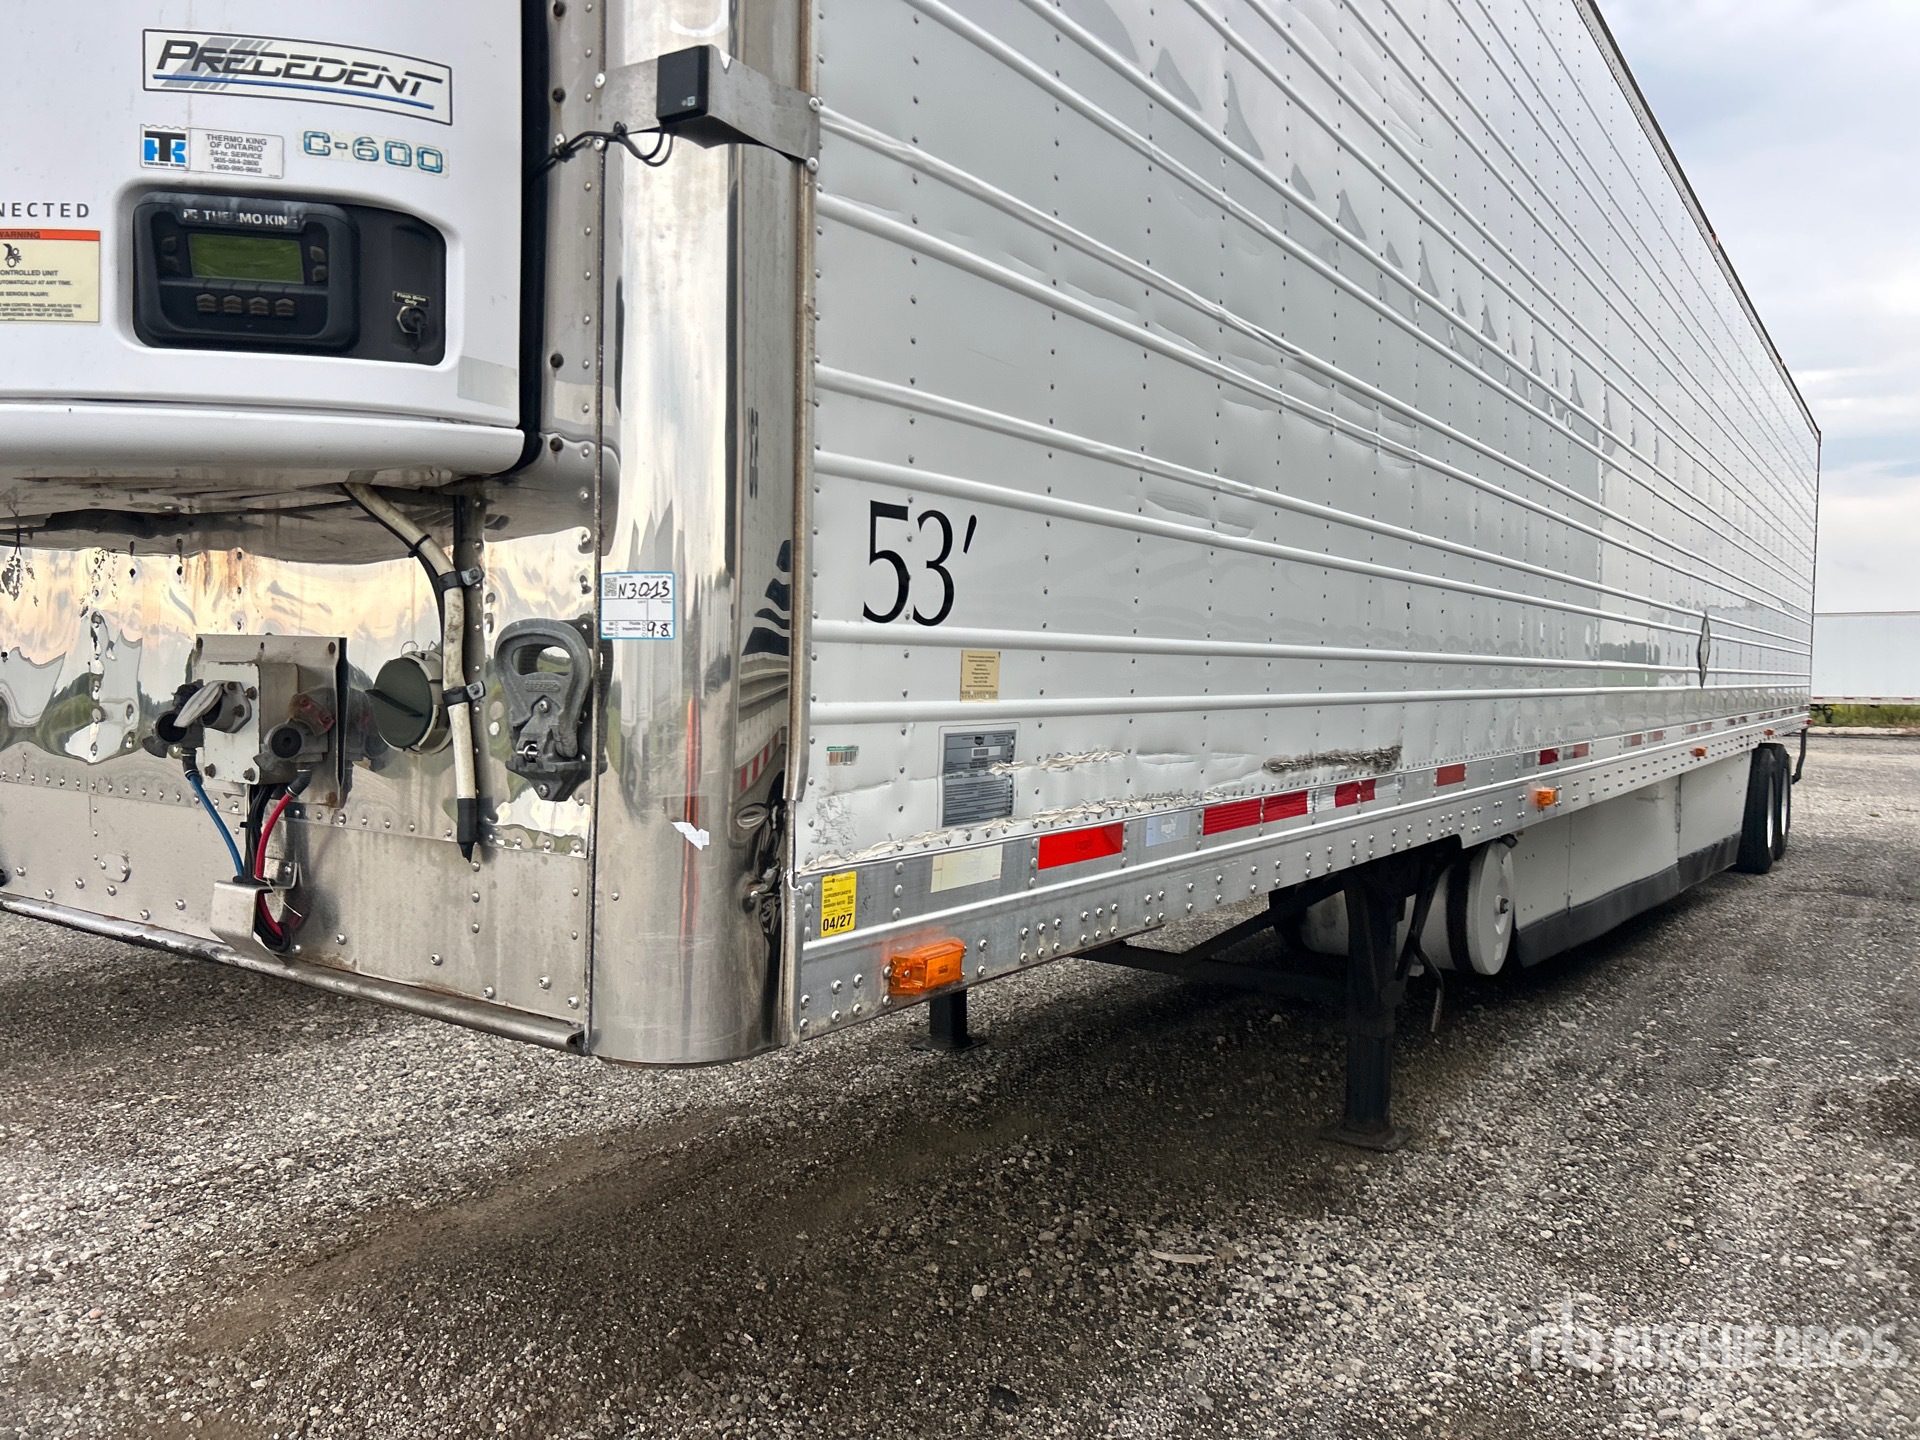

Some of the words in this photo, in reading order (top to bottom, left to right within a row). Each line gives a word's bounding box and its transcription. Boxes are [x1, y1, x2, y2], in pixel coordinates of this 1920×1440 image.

[156, 39, 443, 97] PRECEDENT
[206, 133, 243, 143] THERMO
[246, 137, 267, 146] KING
[209, 141, 222, 149] OF
[224, 142, 263, 152] ONTARIO
[231, 151, 262, 160] SERVICE
[303, 130, 443, 174] C-600
[822, 913, 853, 932] 04/27
